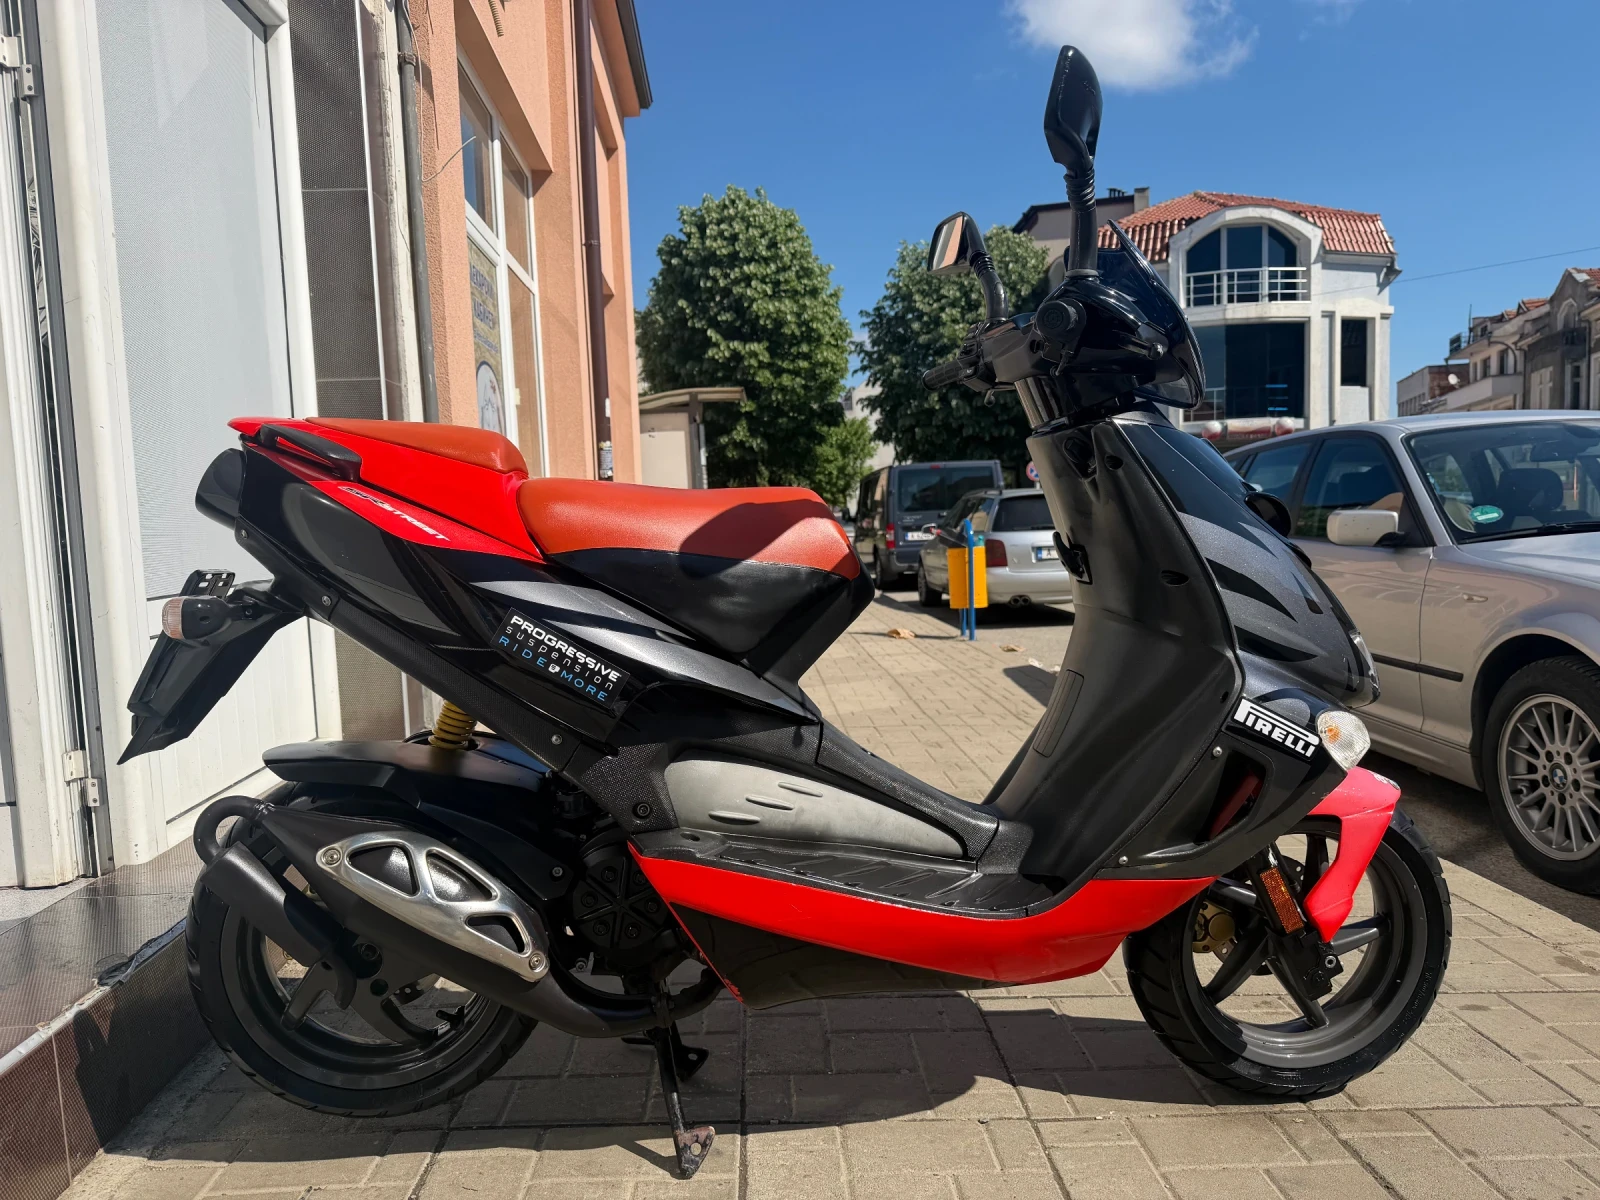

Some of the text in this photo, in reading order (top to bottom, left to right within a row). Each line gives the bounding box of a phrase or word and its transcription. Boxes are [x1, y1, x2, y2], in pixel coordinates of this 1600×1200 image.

[498, 635, 608, 701] RIDE MORE
[510, 615, 620, 682] PROGRESSIVE
[1233, 698, 1320, 757] PIRELLI
